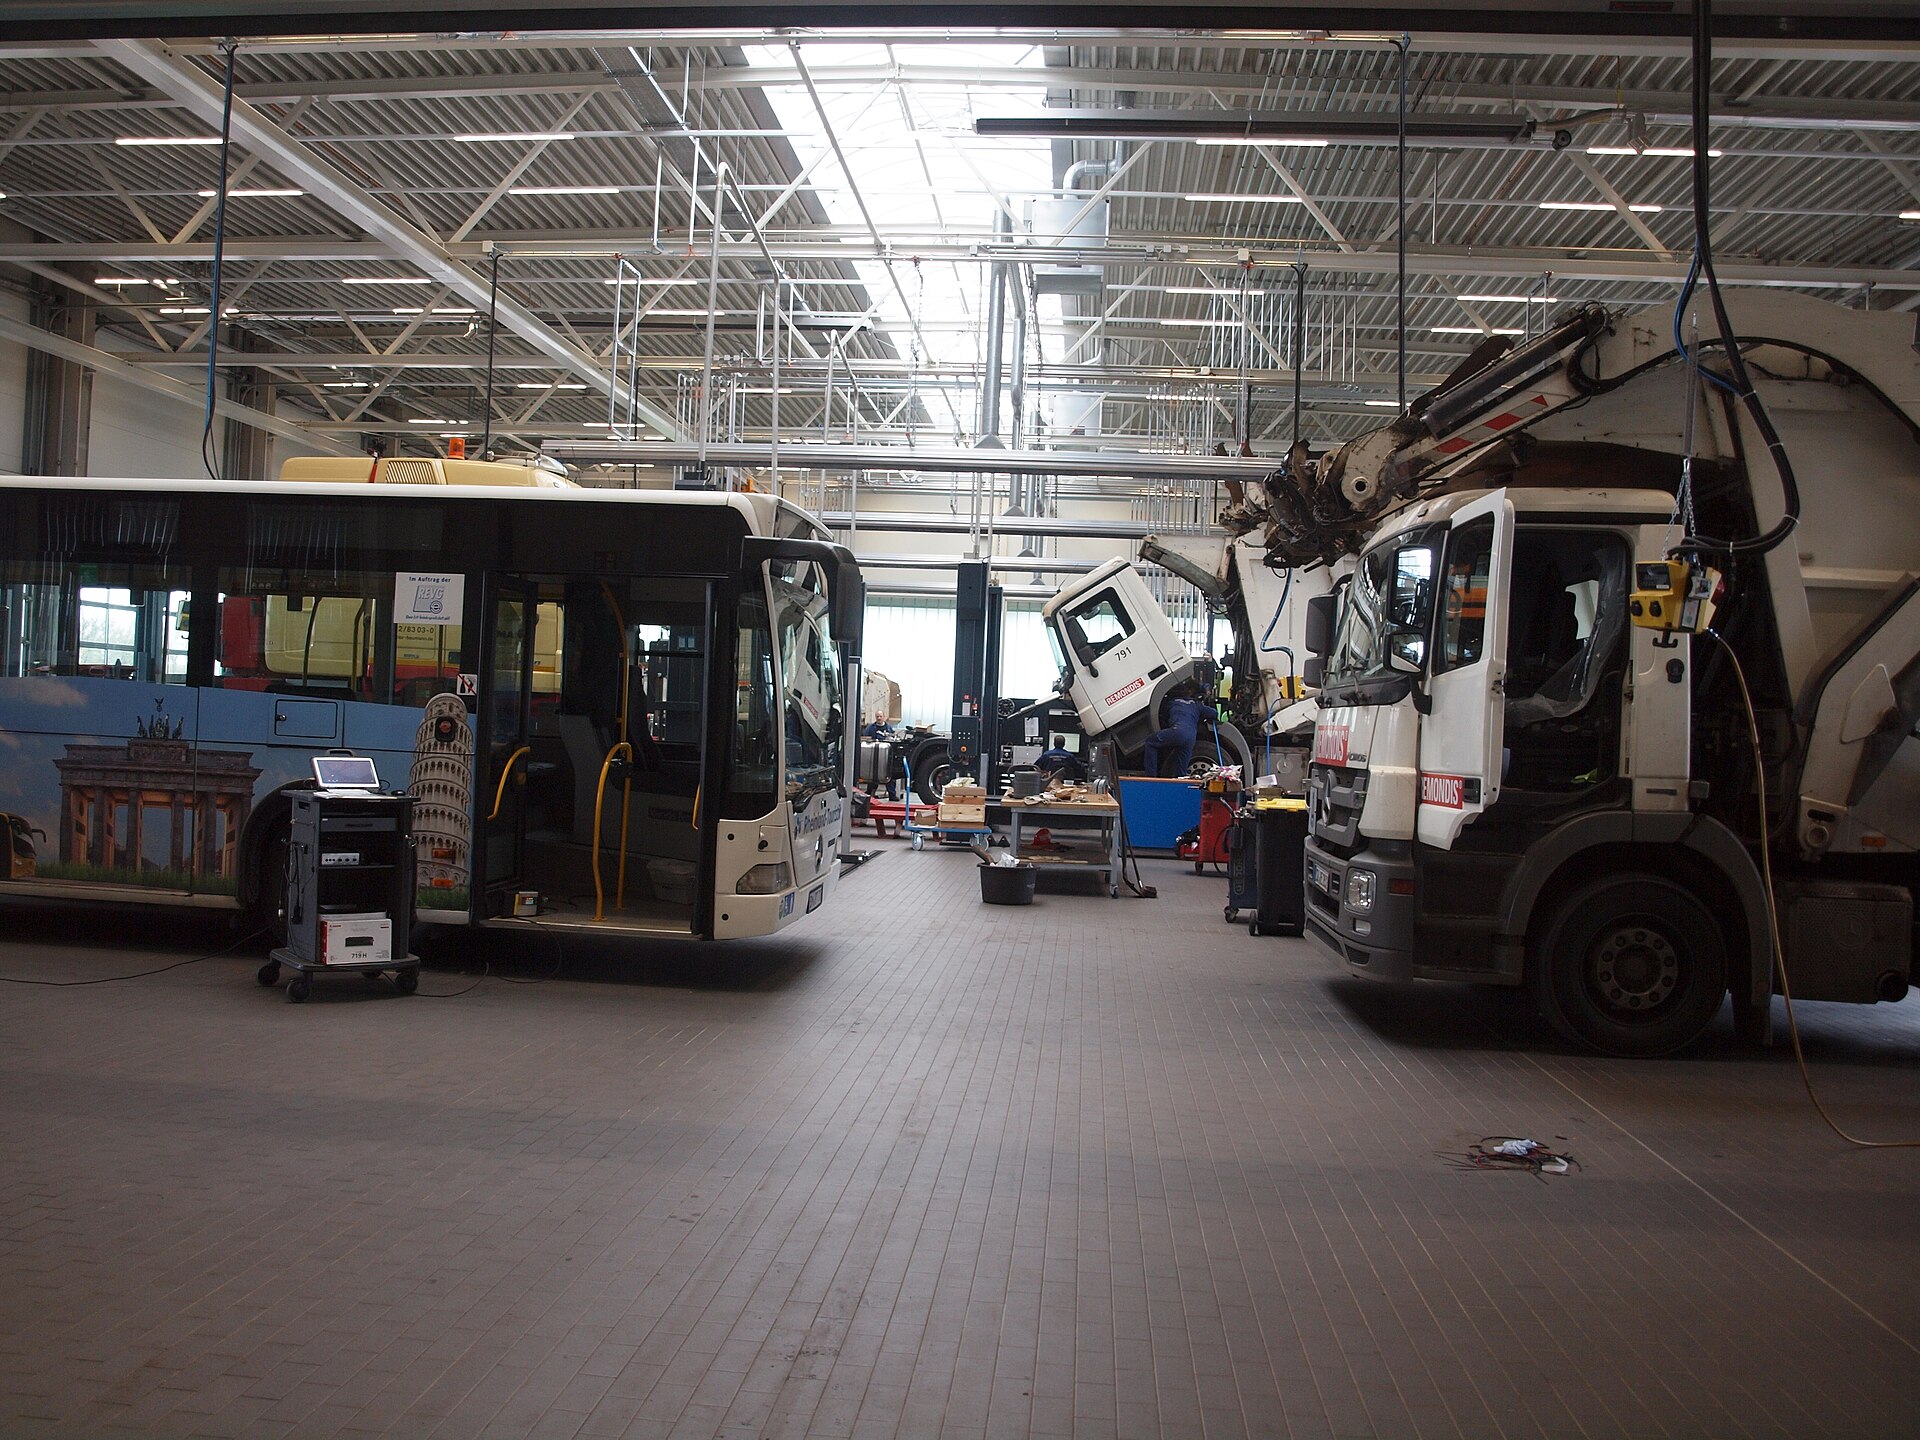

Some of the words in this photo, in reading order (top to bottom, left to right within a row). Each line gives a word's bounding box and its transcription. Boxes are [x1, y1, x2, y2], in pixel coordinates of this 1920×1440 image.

[418, 576, 440, 584] Auftrag
[1115, 646, 1132, 661] 791
[1105, 680, 1142, 706] REMONDIS
